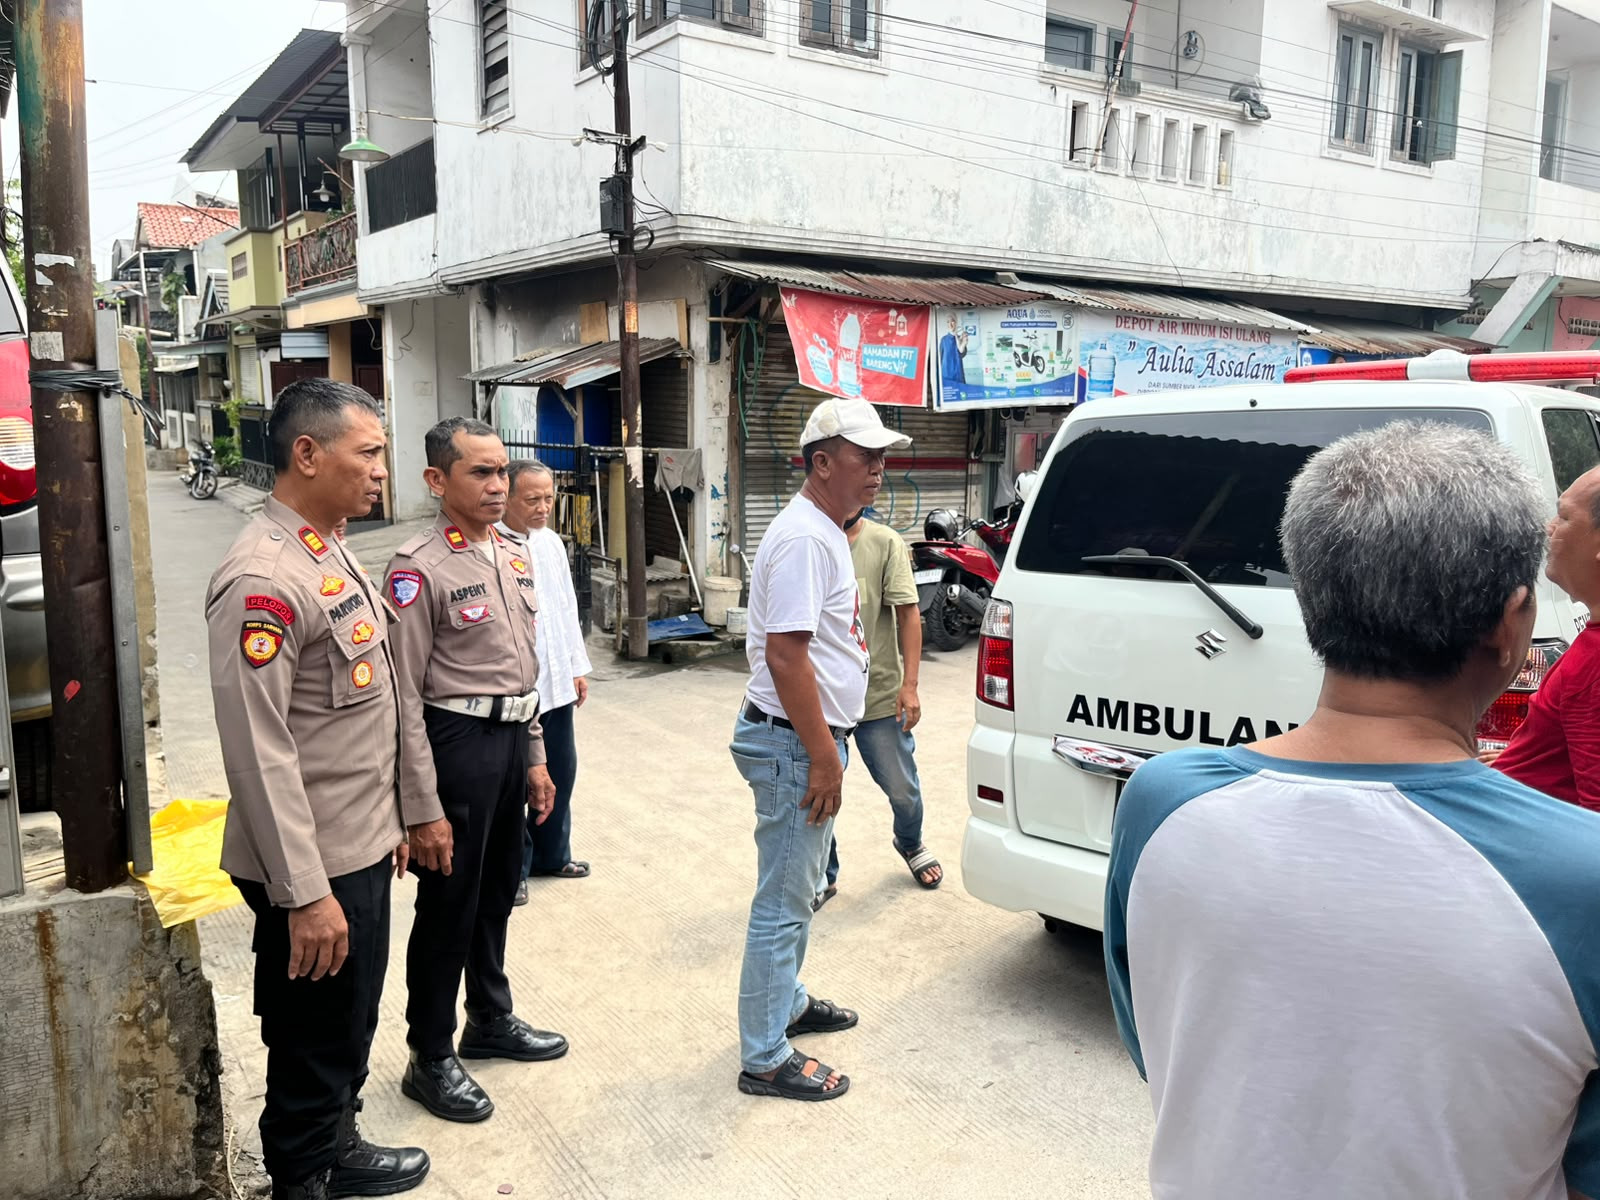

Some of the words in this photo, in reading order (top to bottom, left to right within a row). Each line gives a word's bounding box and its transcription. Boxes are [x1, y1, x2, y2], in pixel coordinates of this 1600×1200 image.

[1007, 309, 1028, 320] AQUA
[1115, 315, 1154, 331] DEPOT
[1158, 320, 1178, 334] AIR
[1181, 322, 1216, 338] MINUM
[1219, 327, 1233, 340] ISI
[1235, 328, 1272, 344] ULANG
[863, 346, 900, 359] RAMADAN
[901, 349, 915, 361] FIT
[866, 358, 892, 371] BARENG
[450, 583, 487, 603] ASPENY
[250, 598, 292, 621] PELOPOR
